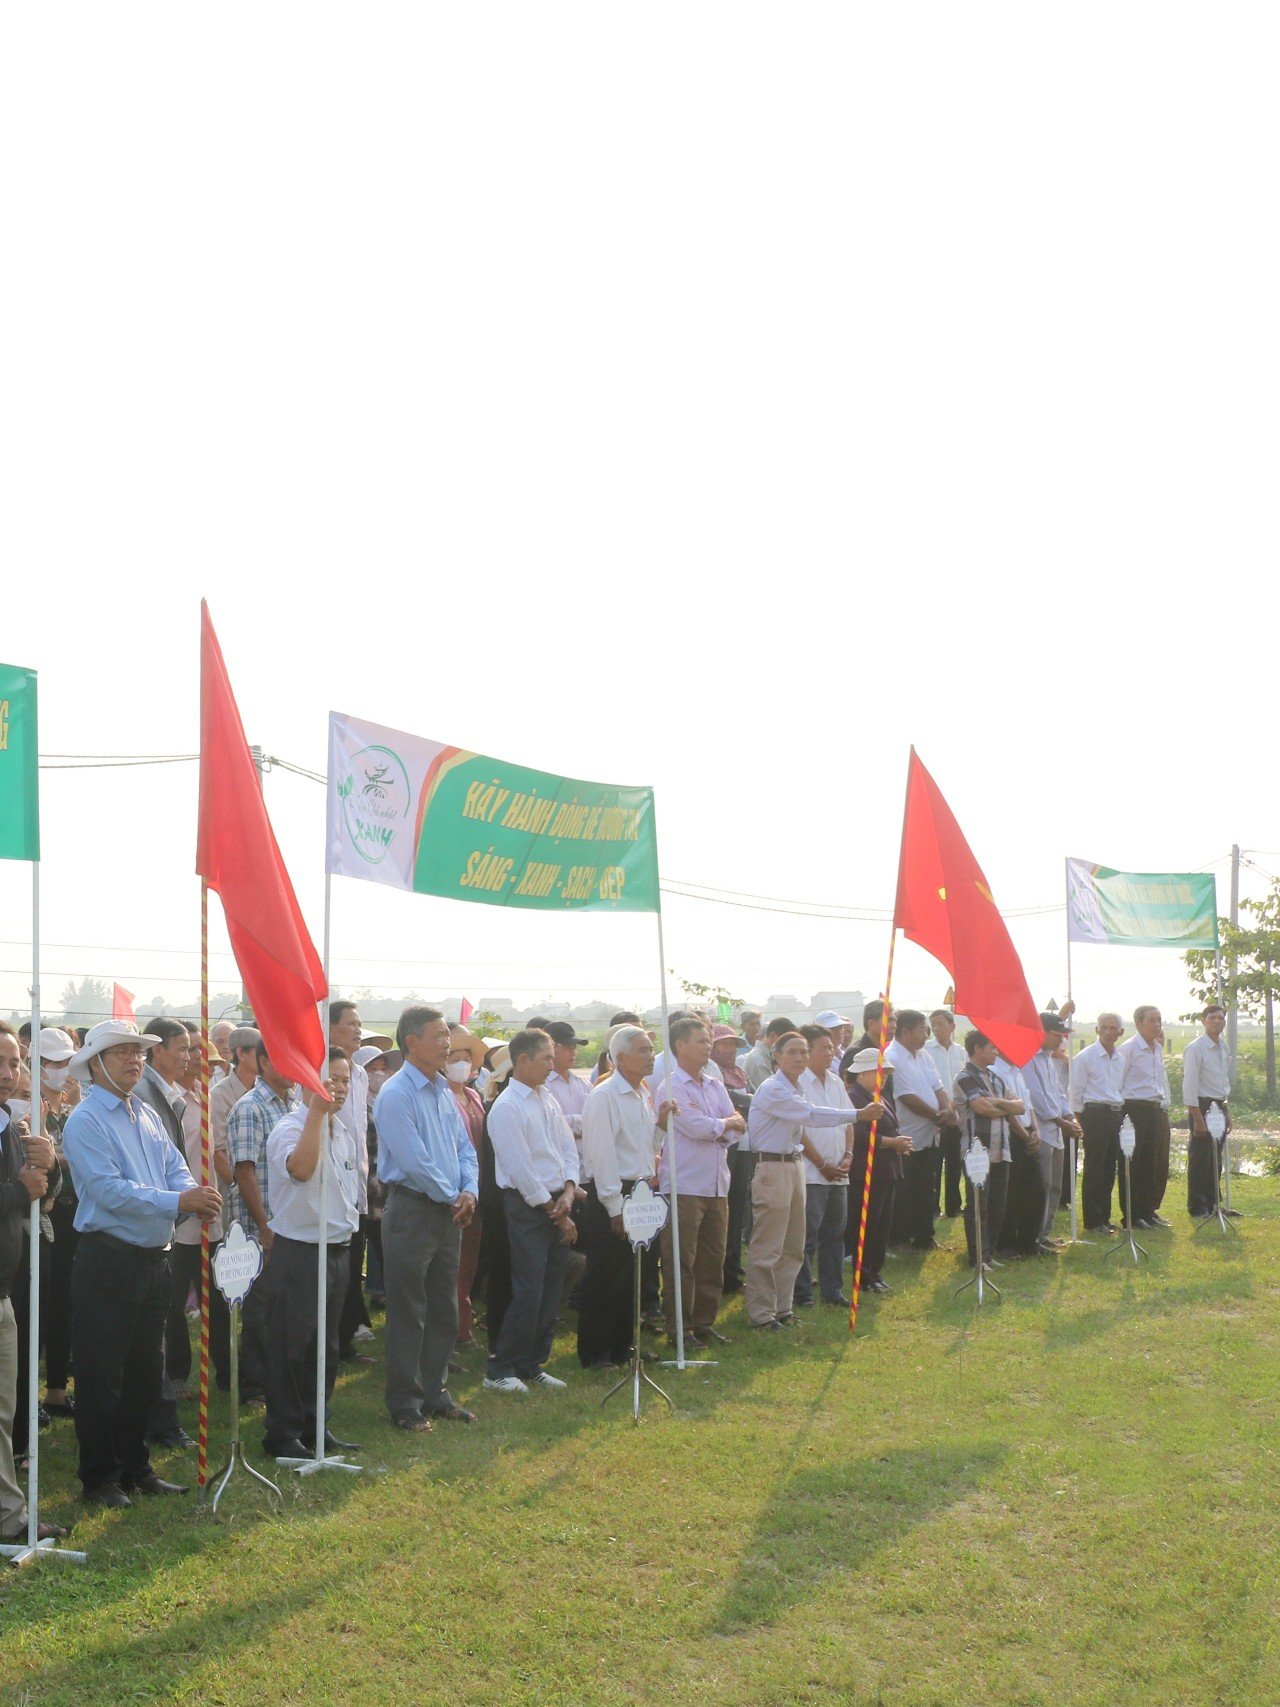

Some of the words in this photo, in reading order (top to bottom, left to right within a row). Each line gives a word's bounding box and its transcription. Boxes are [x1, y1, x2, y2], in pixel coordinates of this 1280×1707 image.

[461, 778, 510, 823] HÃY
[500, 787, 558, 836] HÀNH
[355, 819, 393, 847] XANH
[460, 846, 515, 892] SÁNG
[514, 861, 562, 897] XANH
